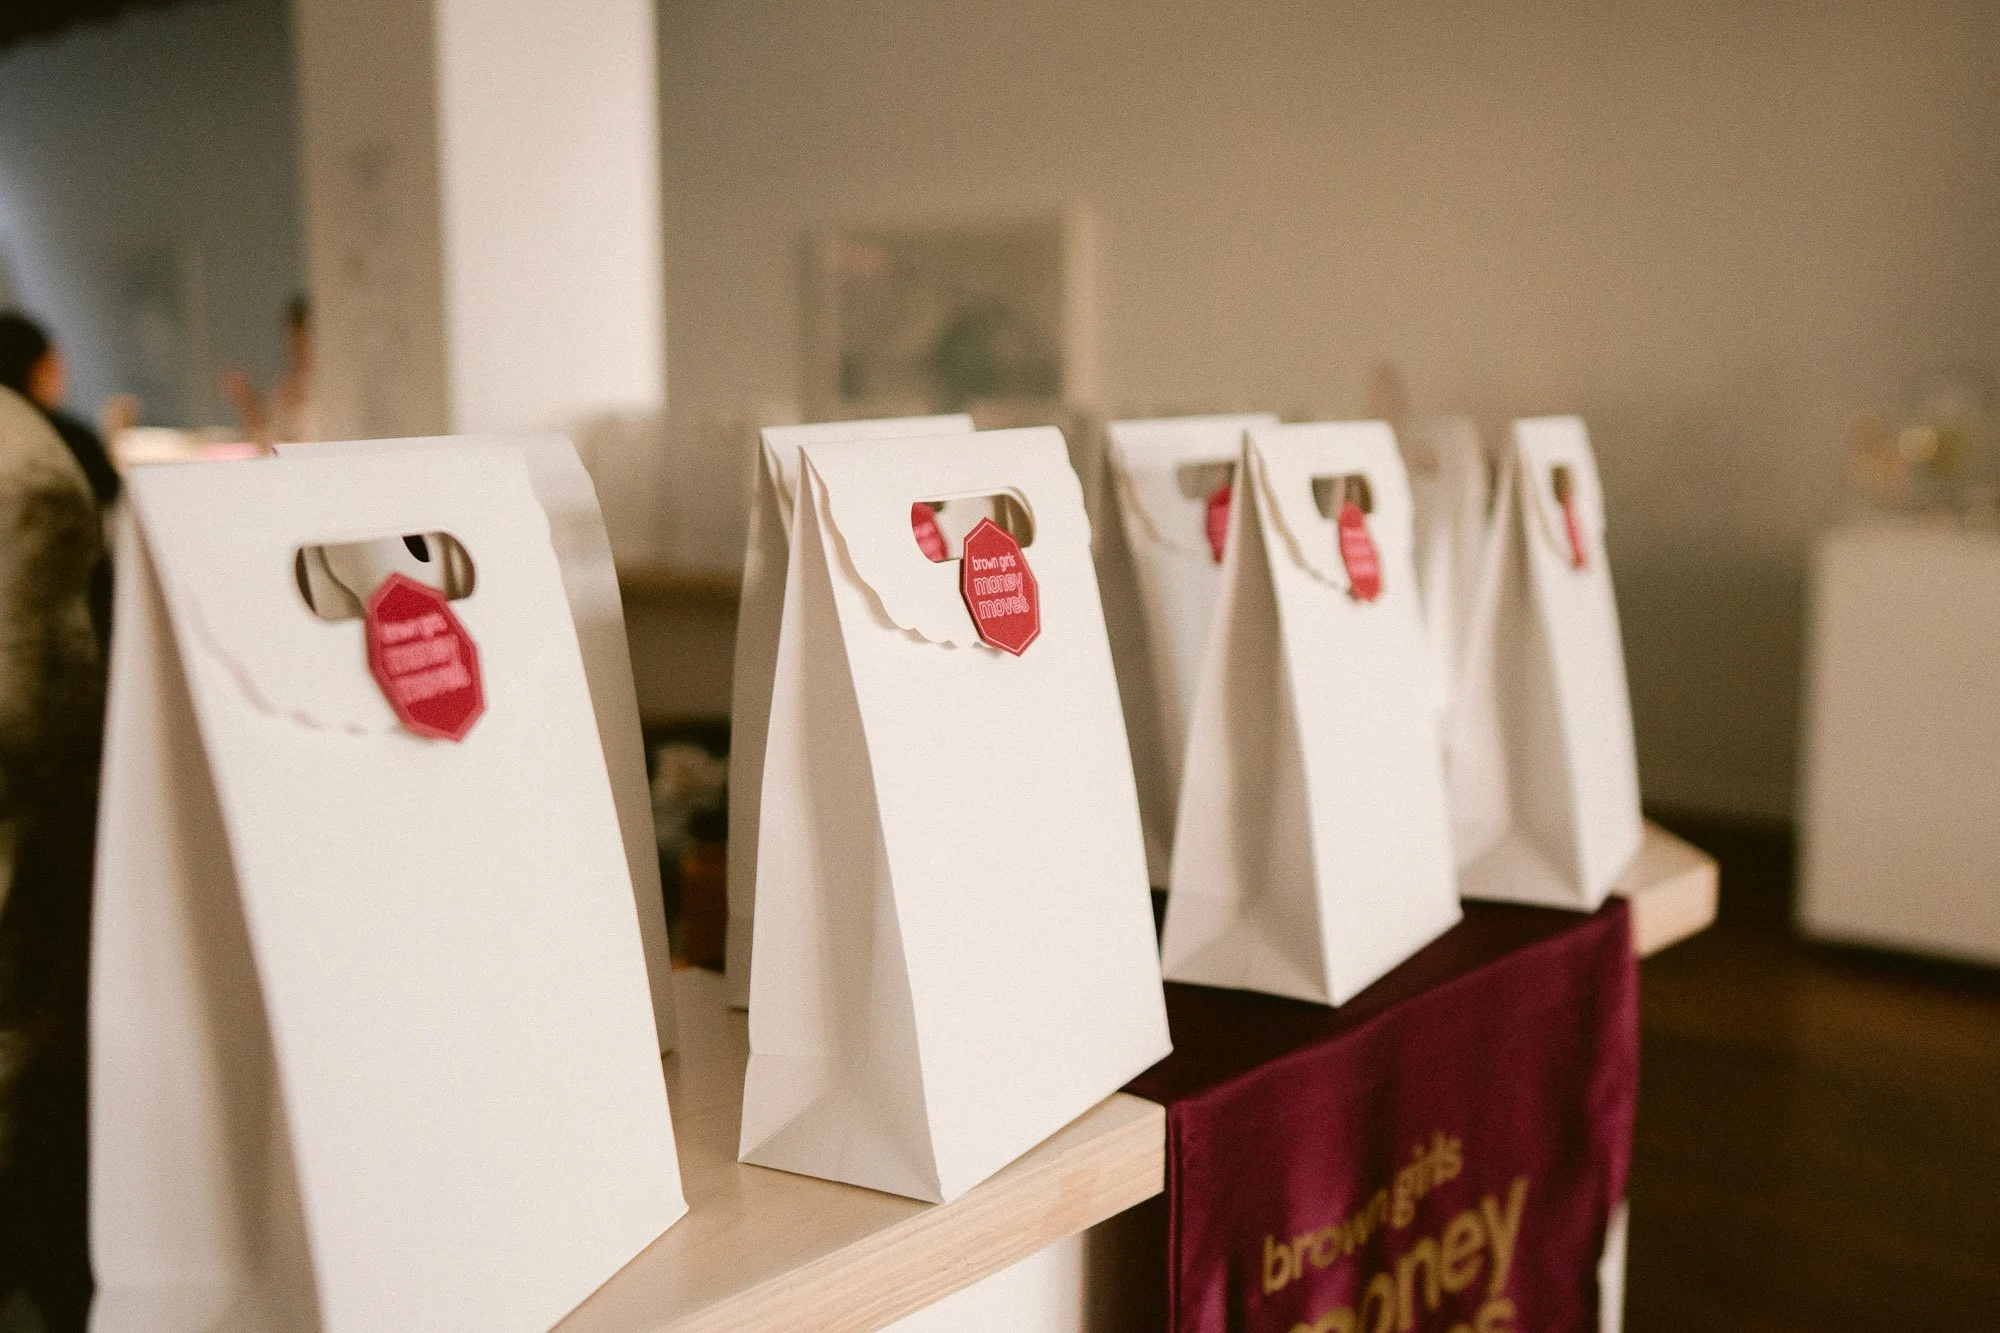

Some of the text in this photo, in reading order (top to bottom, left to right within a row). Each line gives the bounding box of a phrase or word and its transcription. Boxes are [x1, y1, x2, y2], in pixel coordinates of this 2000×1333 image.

[972, 556, 999, 572] brown
[974, 572, 1024, 597] money
[978, 595, 1030, 620] moves
[1262, 1131, 1464, 1296] brown girls
